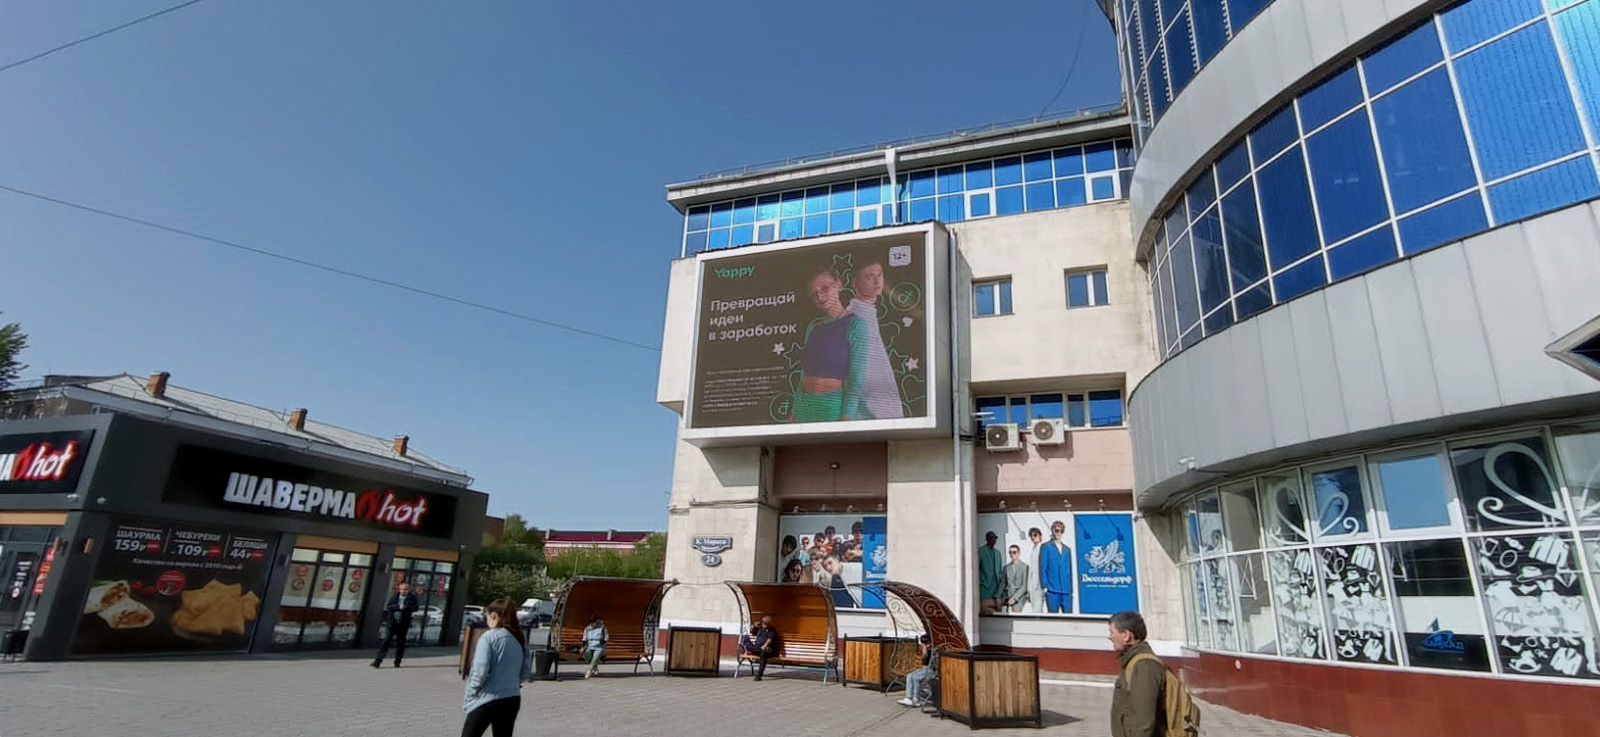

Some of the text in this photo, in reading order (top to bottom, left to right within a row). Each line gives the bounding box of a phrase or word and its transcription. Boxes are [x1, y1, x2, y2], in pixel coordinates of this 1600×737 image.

[714, 266, 755, 279] Yappy
[710, 291, 796, 312] Превращай
[709, 315, 744, 327] идеи
[708, 324, 797, 341] в заработок
[26, 442, 75, 478] hot
[224, 472, 428, 526] ШАВЕРМА hot
[116, 530, 161, 541] ШАУРМА
